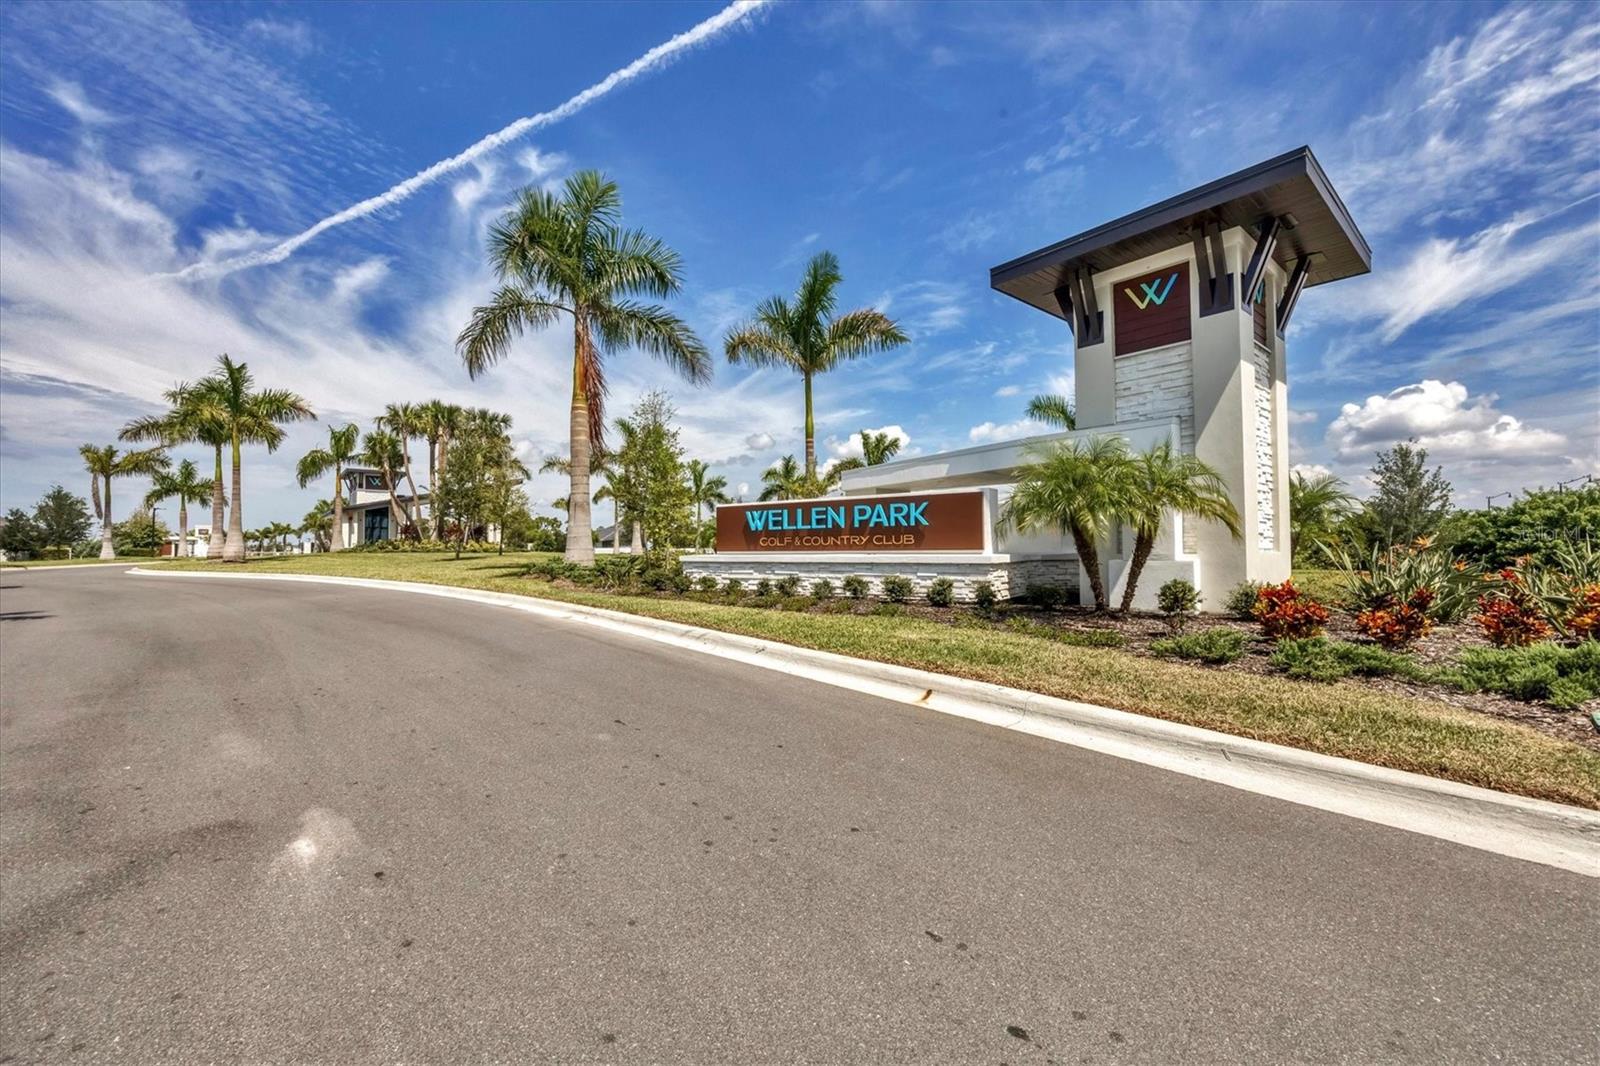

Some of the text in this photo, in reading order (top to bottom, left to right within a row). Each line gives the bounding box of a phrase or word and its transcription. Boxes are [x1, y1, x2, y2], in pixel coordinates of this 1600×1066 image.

[745, 501, 929, 532] WELLEN PARK
[760, 534, 915, 547] GOLF & COUNTRY CLUB
